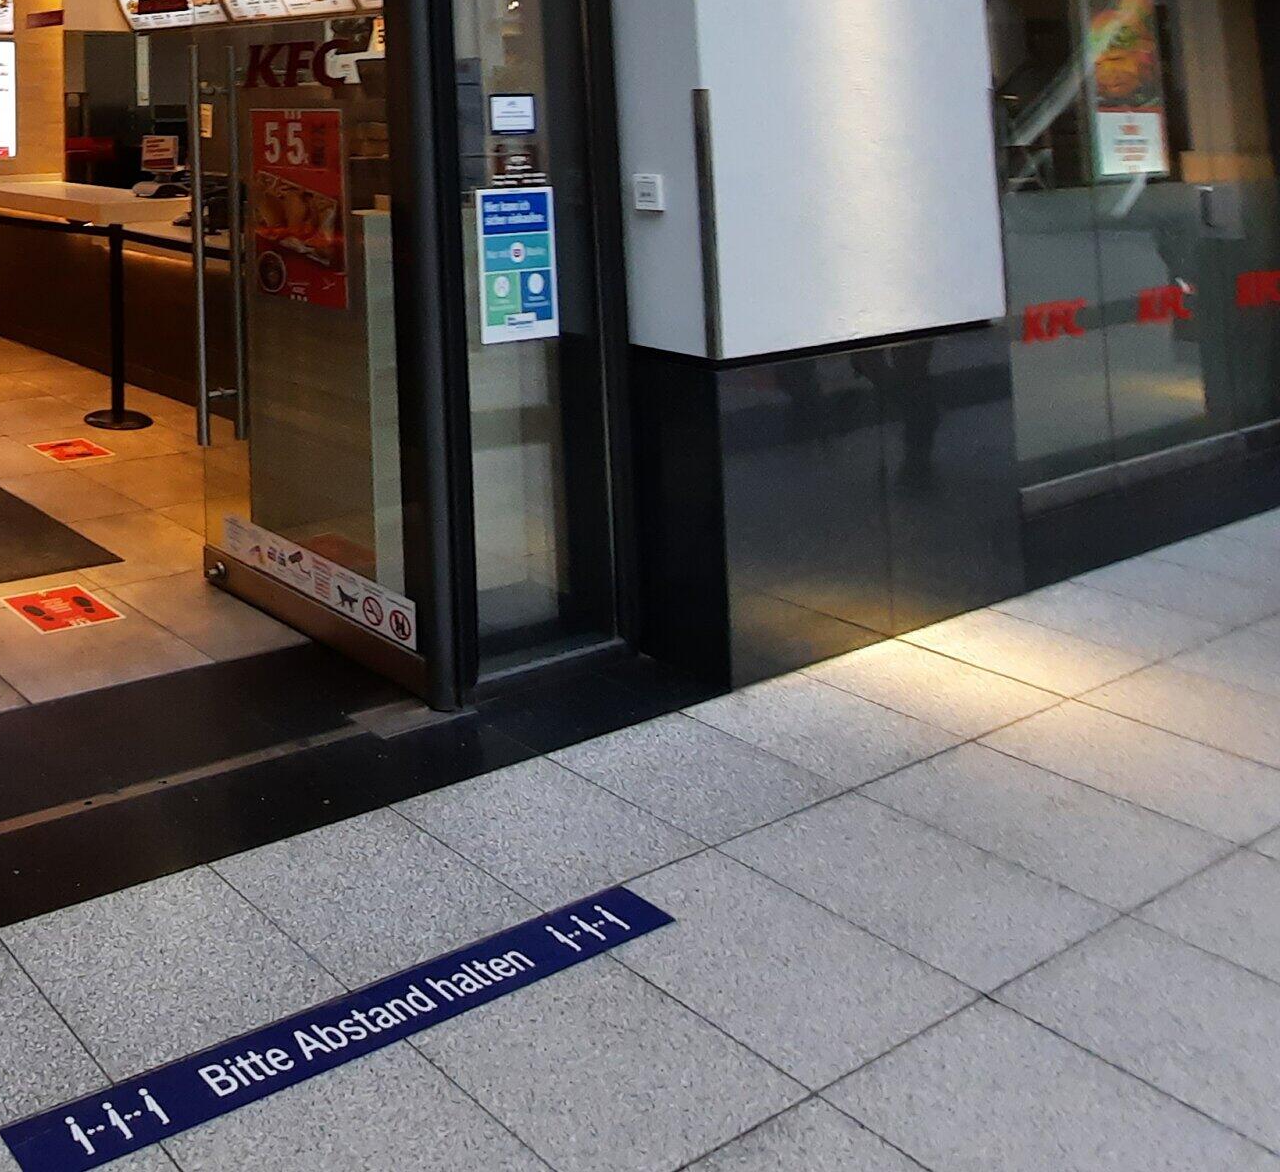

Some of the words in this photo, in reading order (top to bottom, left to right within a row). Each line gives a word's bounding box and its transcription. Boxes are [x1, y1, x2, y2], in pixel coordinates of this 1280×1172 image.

[243, 38, 352, 89] KFC
[1023, 297, 1087, 344] KFC
[198, 1047, 295, 1097] Bitte
[293, 984, 438, 1061] Abstand
[424, 950, 536, 1001] halten
